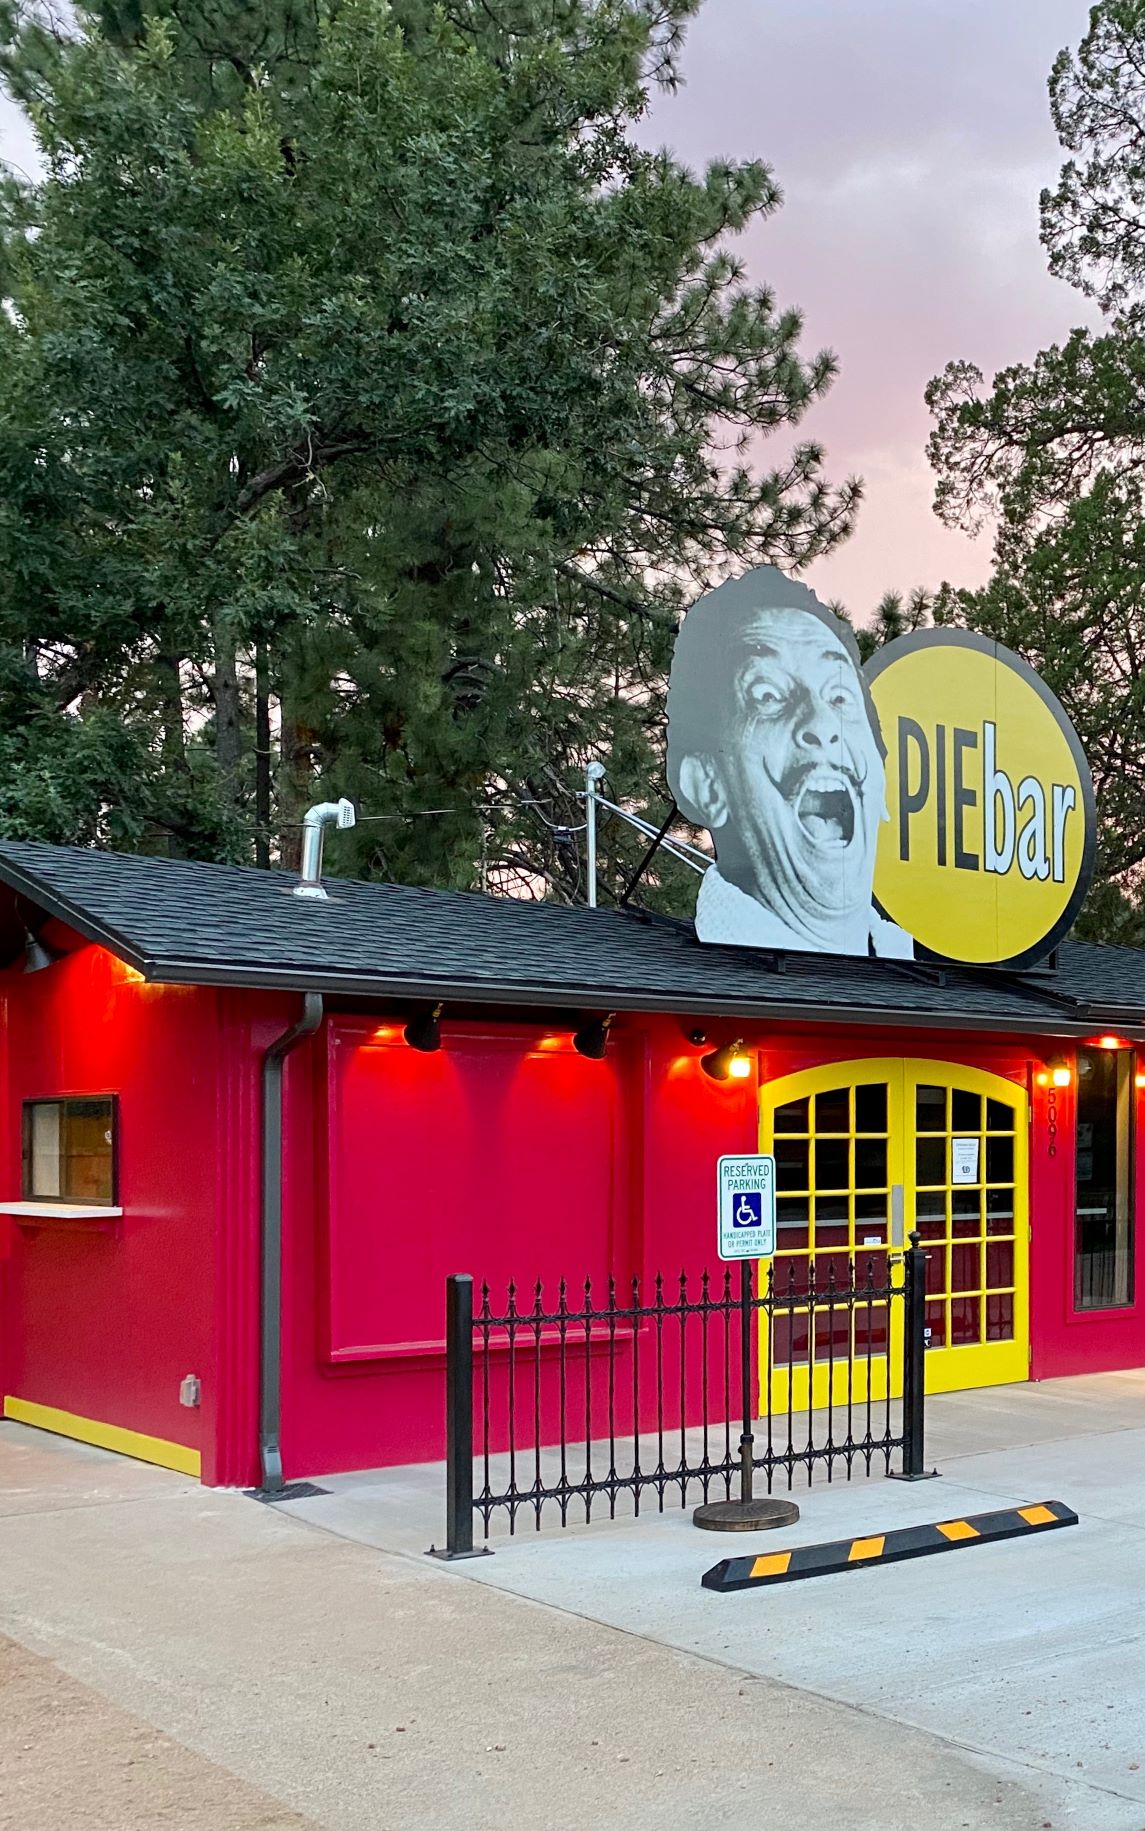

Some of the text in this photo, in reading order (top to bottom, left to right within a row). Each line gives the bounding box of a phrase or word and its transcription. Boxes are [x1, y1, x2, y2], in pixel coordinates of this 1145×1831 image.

[1048, 1088, 1057, 1158] 5096
[723, 1164, 770, 1177] RESERVED
[727, 1178, 766, 1191] PARKING
[723, 1229, 771, 1239] HANDICAPPED PLATE
[727, 1238, 767, 1248] OR PERMIT ONLY
